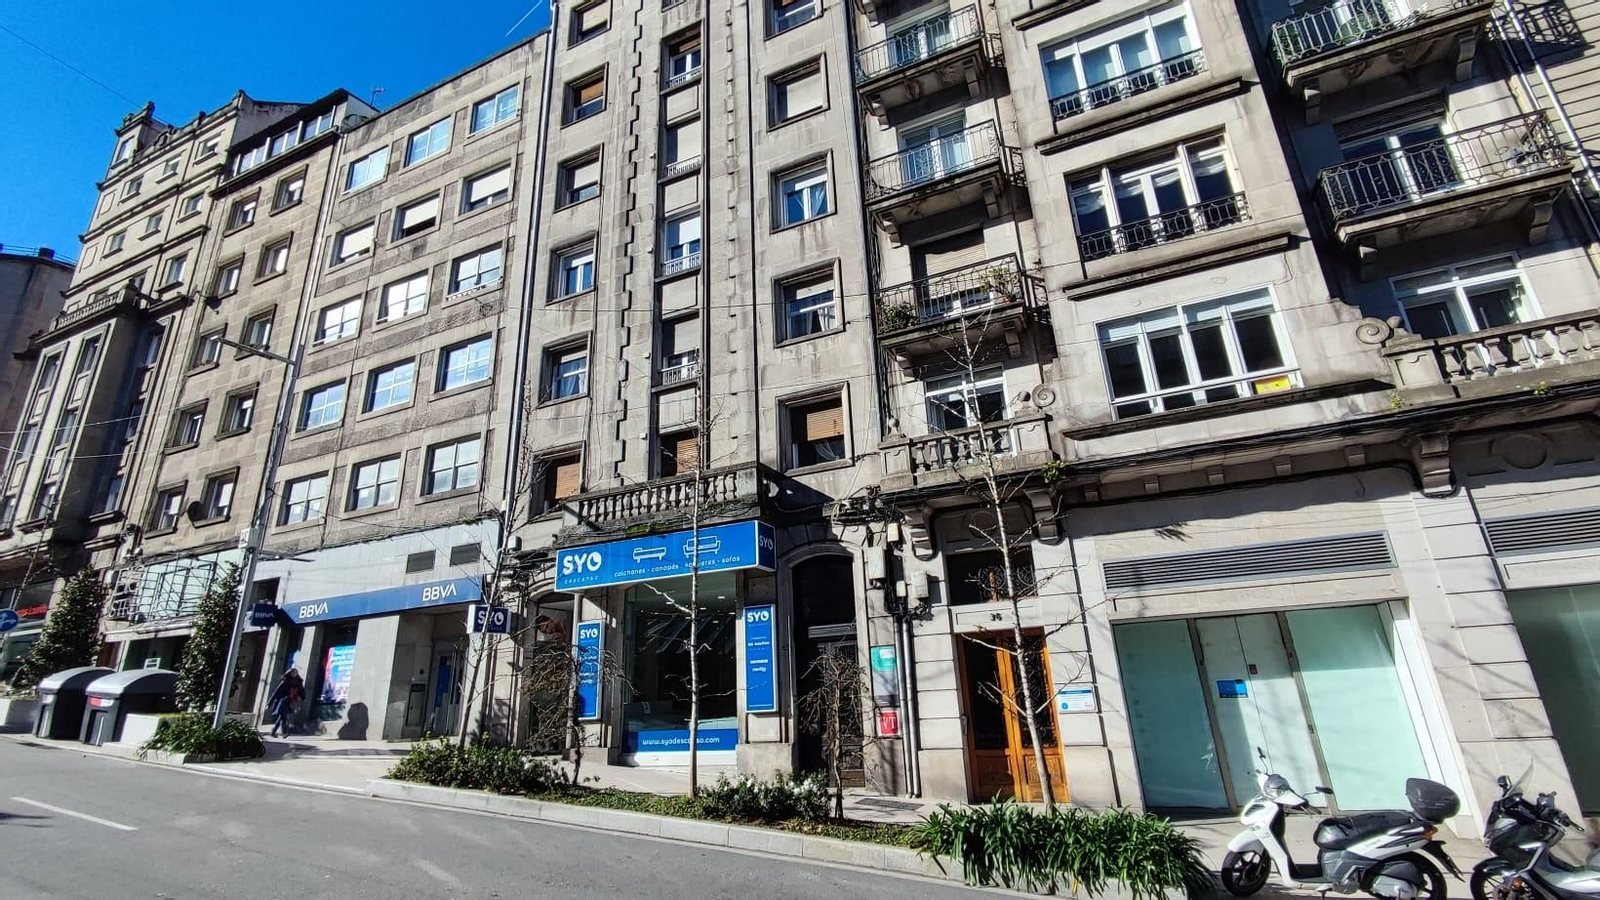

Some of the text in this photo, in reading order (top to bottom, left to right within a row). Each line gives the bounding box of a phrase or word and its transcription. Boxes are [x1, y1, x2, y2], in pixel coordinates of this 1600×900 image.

[759, 535, 774, 550] SYO
[563, 551, 602, 576] SYO
[422, 582, 457, 602] BBVA
[299, 601, 329, 619] BBVA
[746, 610, 770, 623] SYO
[580, 628, 599, 640] SYO
[642, 736, 720, 746] www.syodescaso.com
